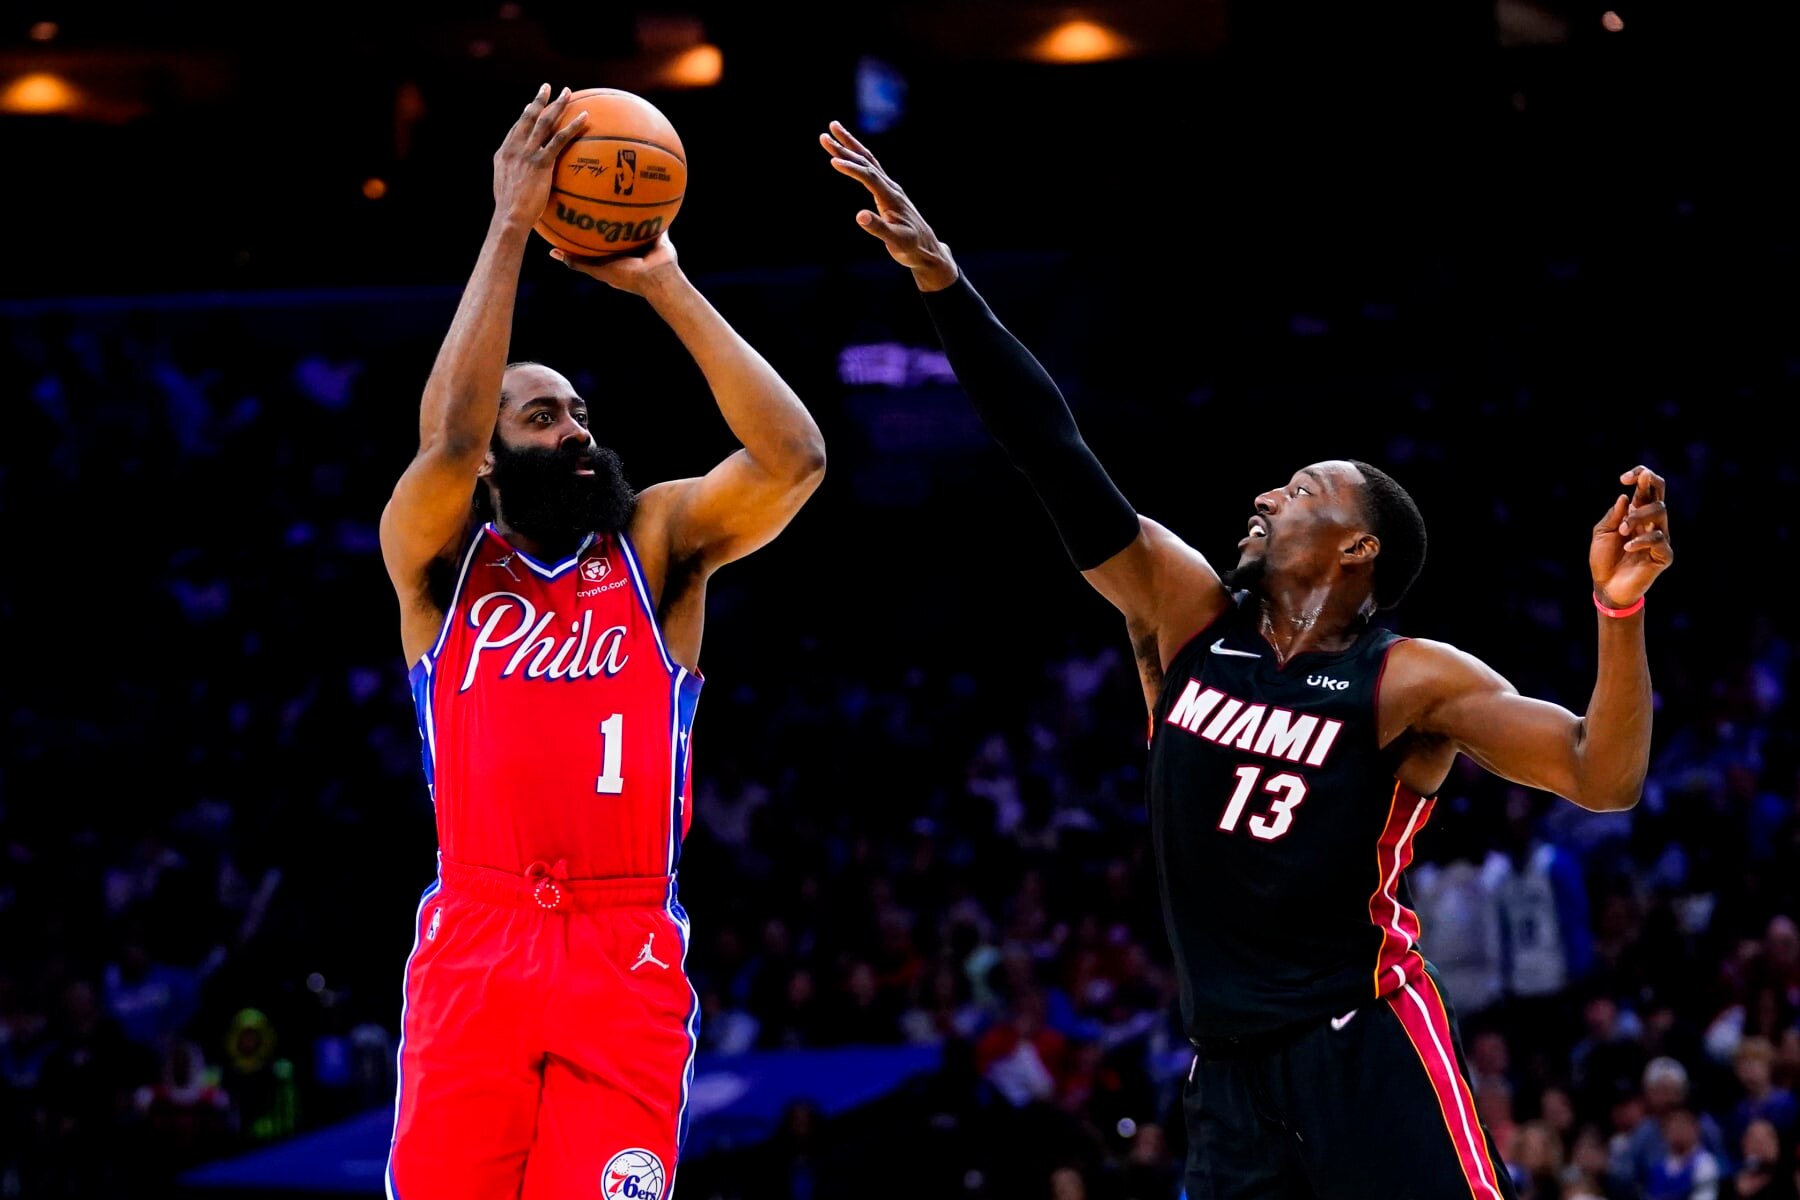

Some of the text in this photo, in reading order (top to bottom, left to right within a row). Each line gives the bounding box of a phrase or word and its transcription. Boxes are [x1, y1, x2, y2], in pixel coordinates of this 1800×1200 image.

[556, 202, 663, 242] Wilson
[577, 578, 628, 597] crypto.com
[459, 591, 629, 694] Phila
[596, 712, 624, 794] 1
[1166, 678, 1343, 767] MIAMI
[1217, 764, 1309, 841] 13
[608, 1170, 657, 1200] 76ers
